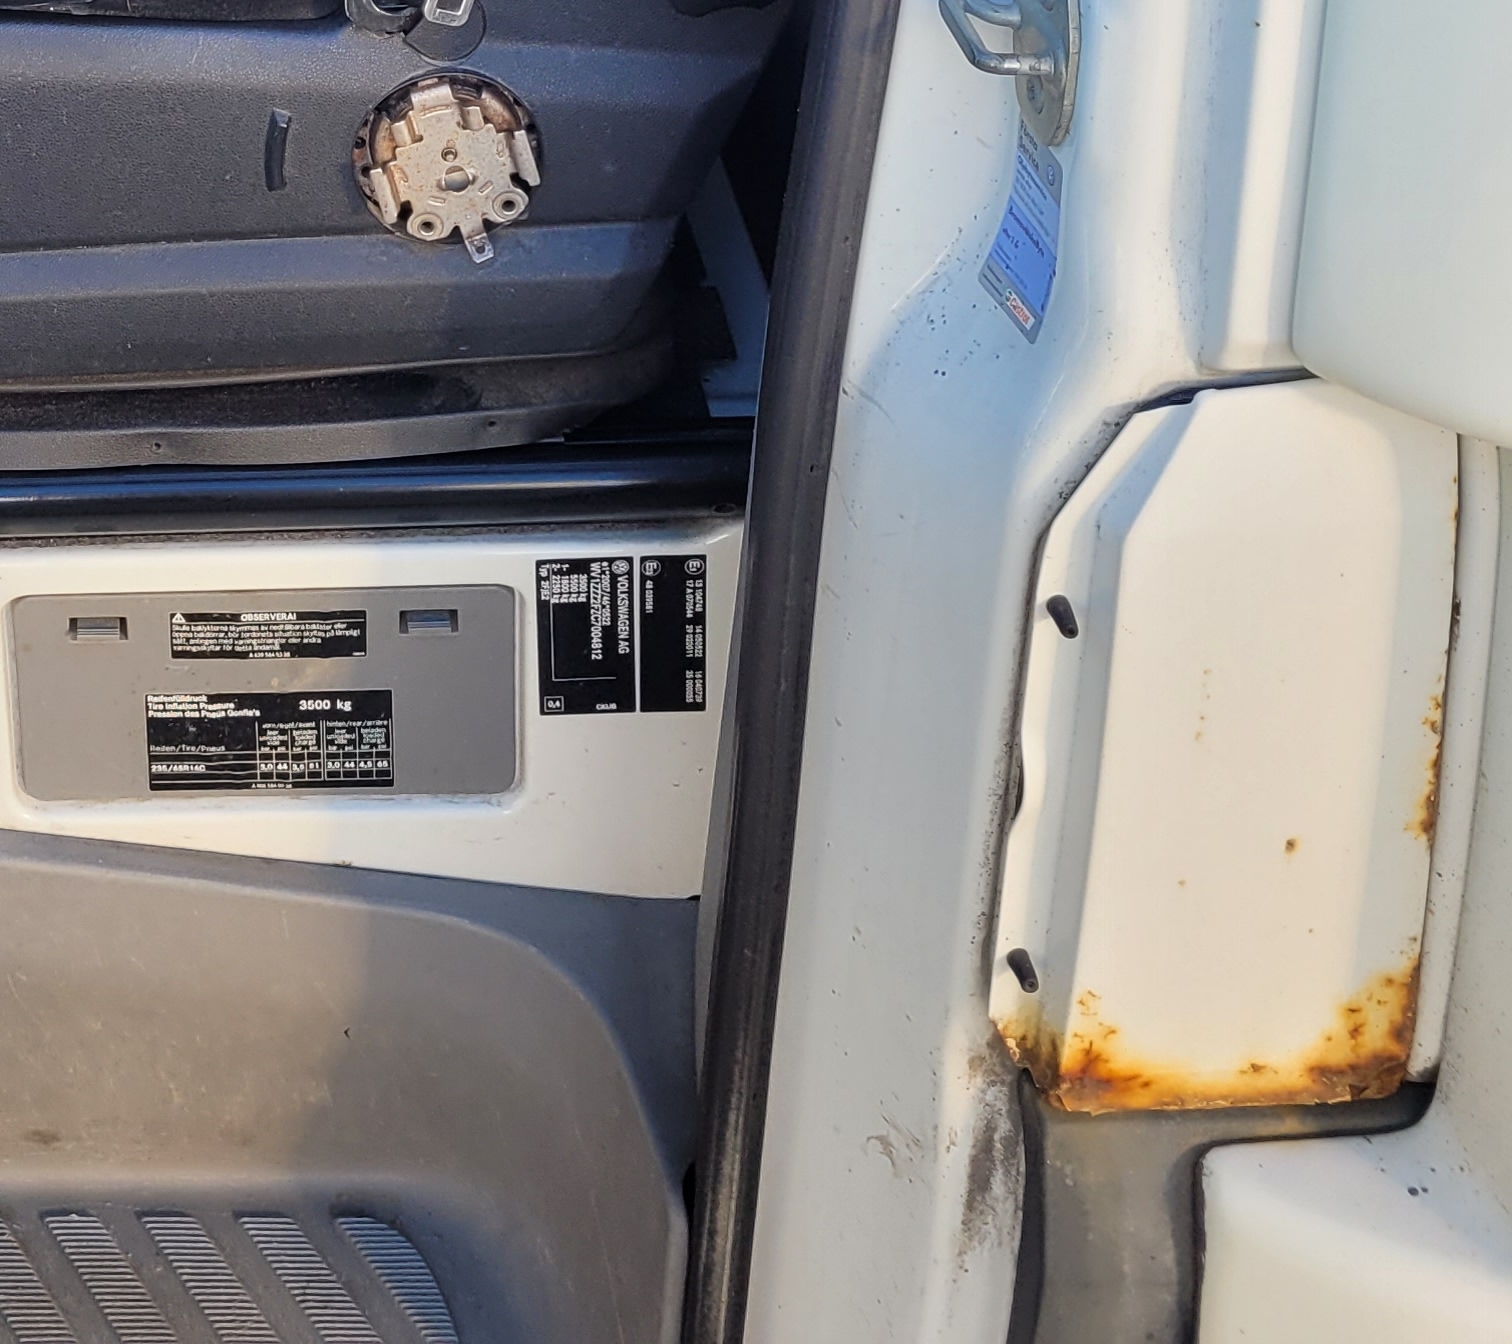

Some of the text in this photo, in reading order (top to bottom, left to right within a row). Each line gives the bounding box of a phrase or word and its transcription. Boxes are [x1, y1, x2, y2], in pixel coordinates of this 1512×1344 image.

[539, 563, 550, 577] Typ
[240, 613, 297, 622] OBSERVERA!
[617, 575, 629, 654] VOLKSWAGEN AG
[148, 702, 164, 710] Tire
[299, 698, 352, 711] 3500 kg
